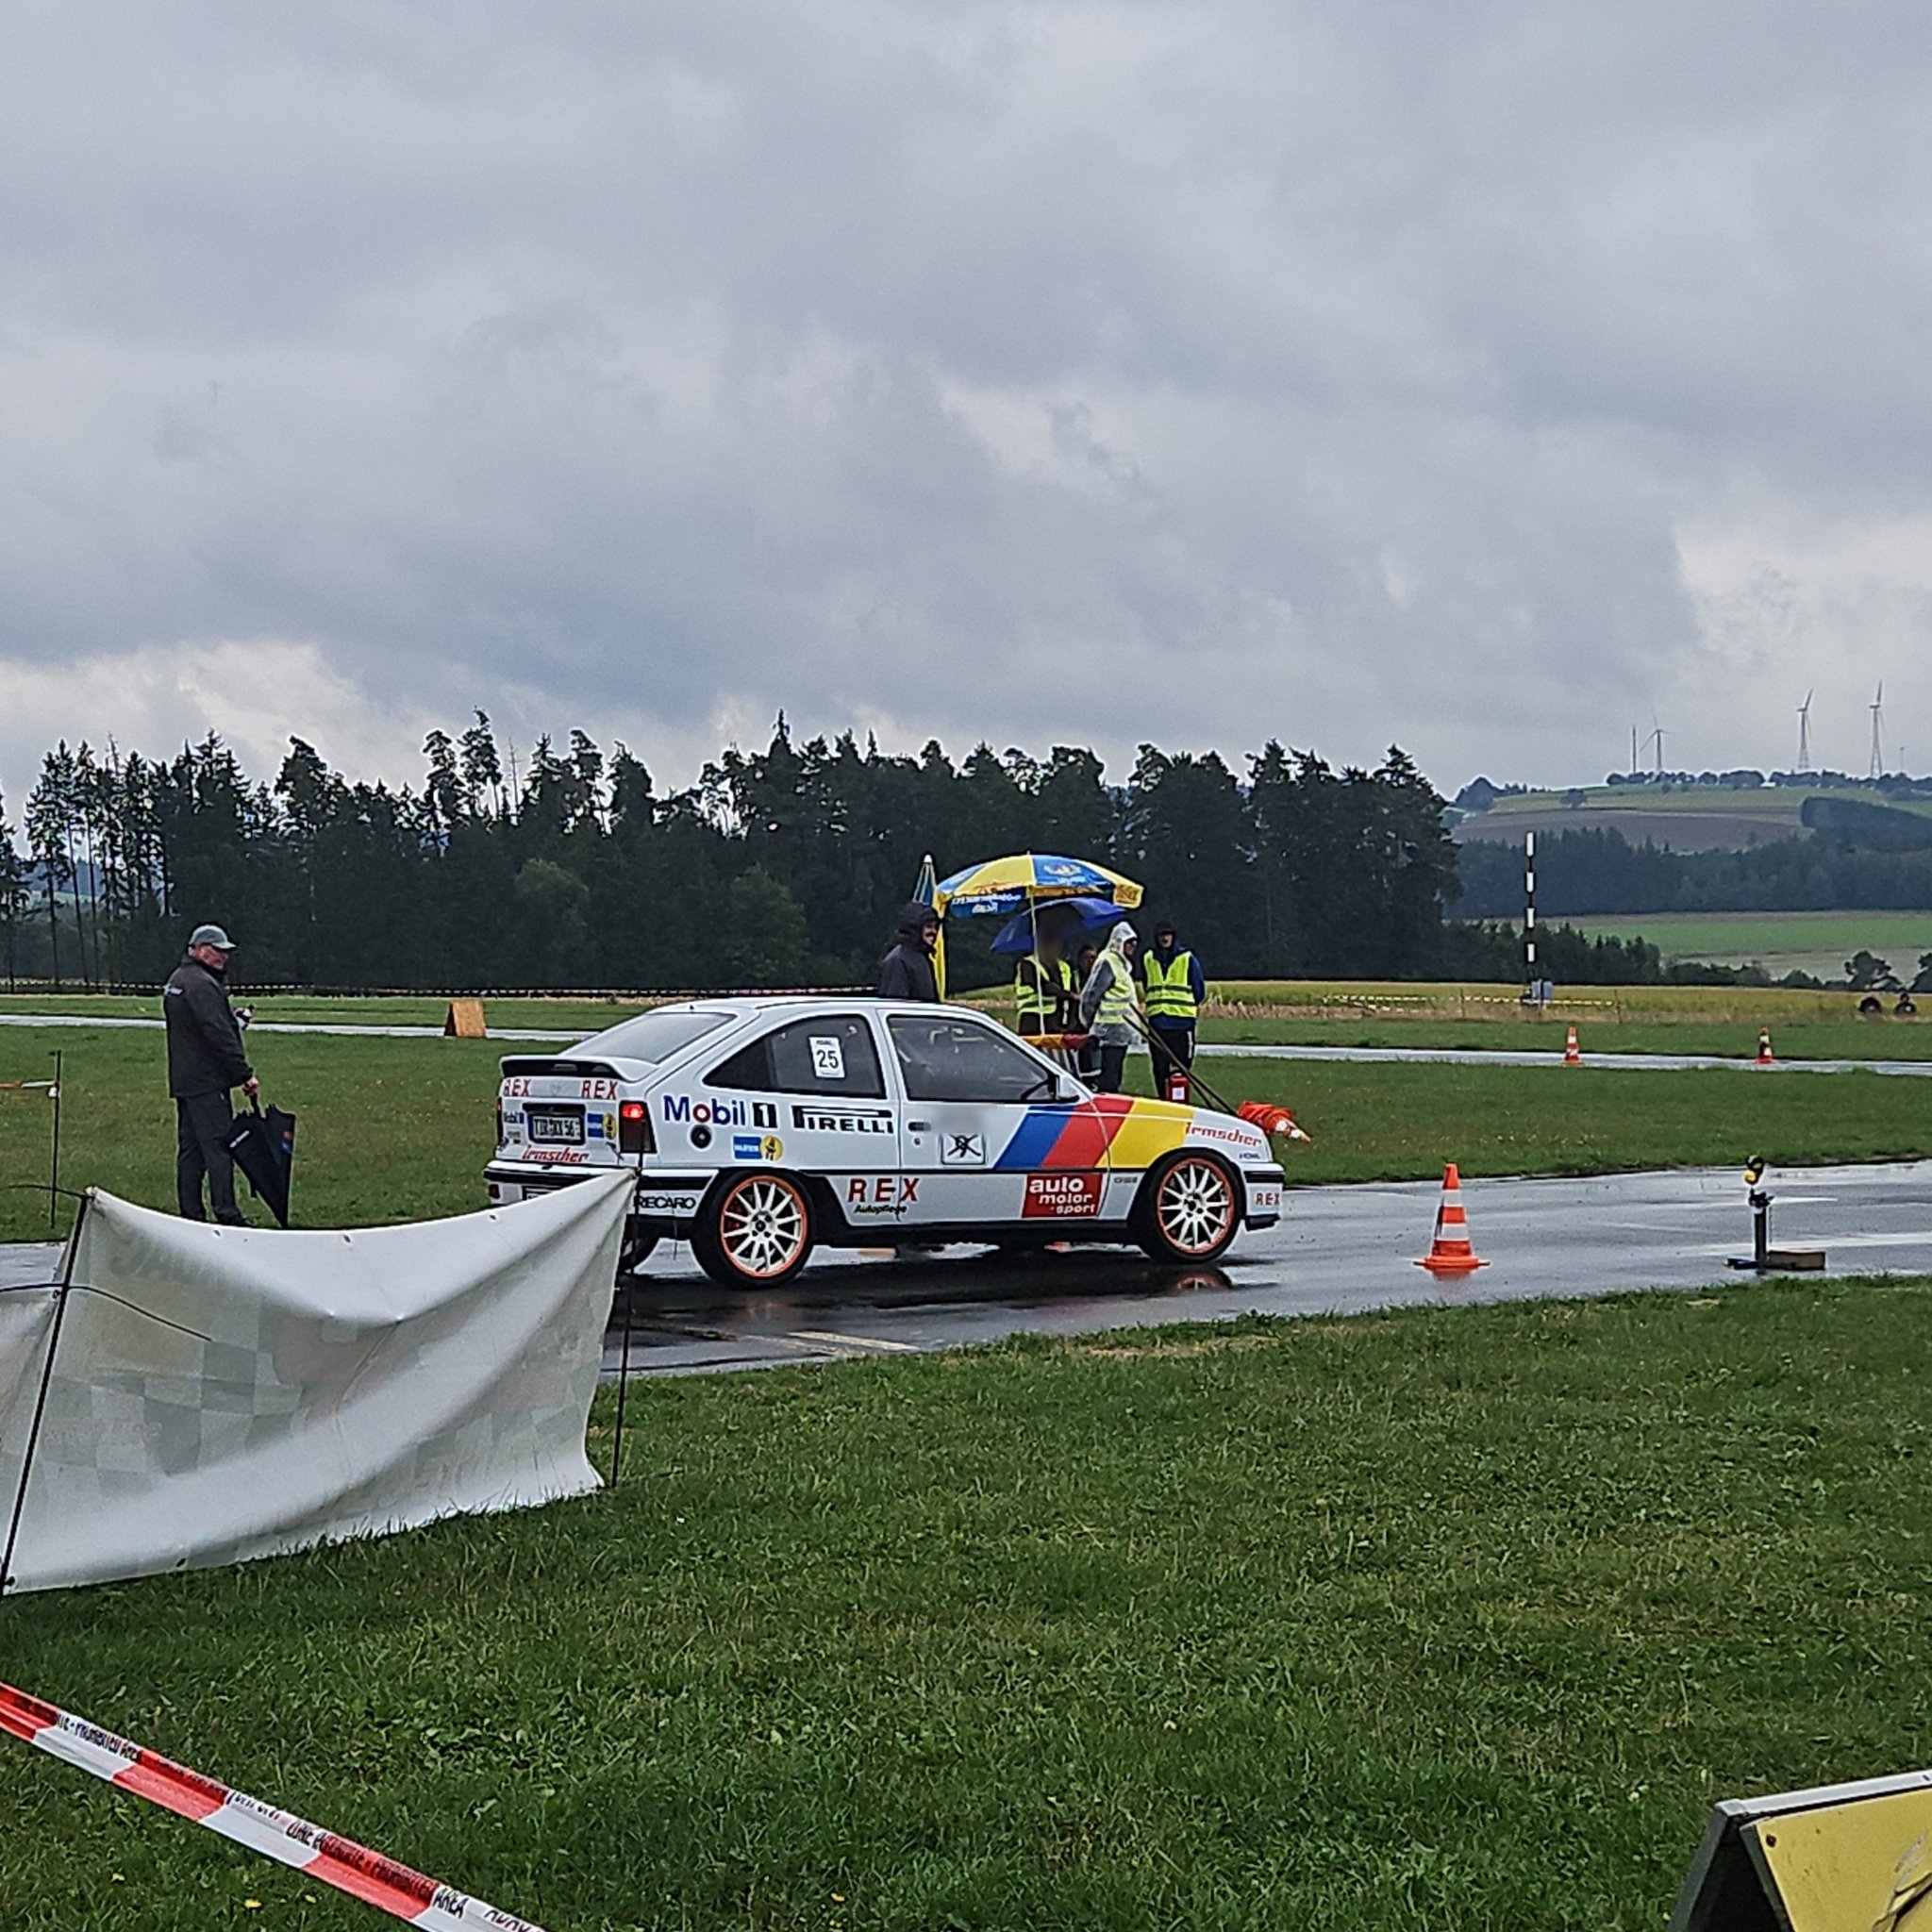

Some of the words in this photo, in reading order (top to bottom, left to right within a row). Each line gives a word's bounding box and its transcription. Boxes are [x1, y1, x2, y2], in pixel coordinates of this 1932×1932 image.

[816, 1049, 839, 1069] 25
[503, 1078, 530, 1096] REX
[581, 1080, 618, 1100] REX
[663, 1095, 745, 1125] Mobil
[791, 1105, 894, 1134] PIRELLI
[847, 1177, 920, 1203] REX
[1029, 1176, 1084, 1193] auto
[638, 1194, 696, 1210] RECARO
[1039, 1193, 1092, 1205] motor
[1255, 1192, 1280, 1206] REX
